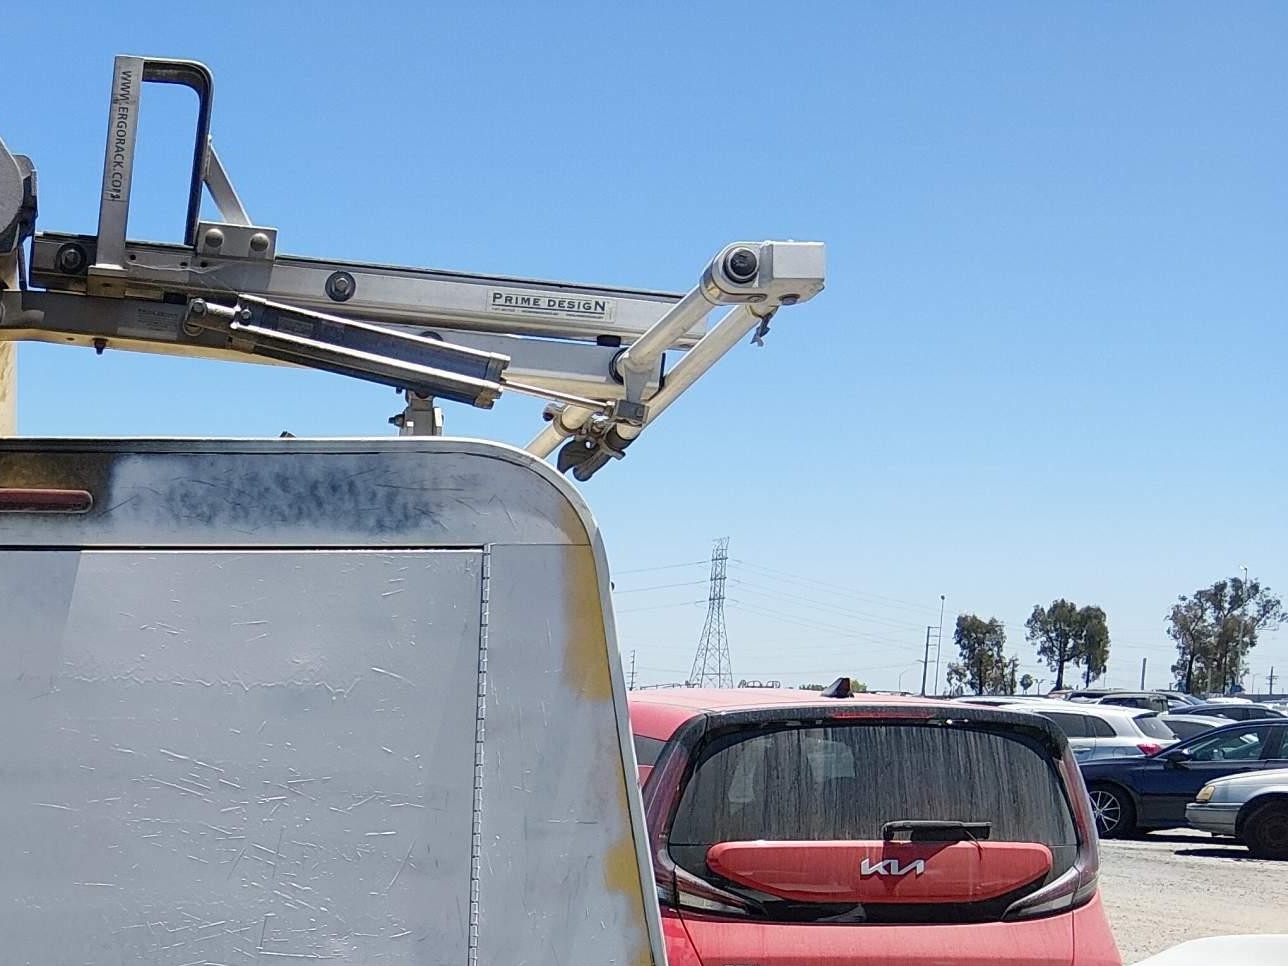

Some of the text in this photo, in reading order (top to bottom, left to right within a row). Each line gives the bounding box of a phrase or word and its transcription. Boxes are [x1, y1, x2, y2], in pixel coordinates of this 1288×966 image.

[492, 292, 606, 312] PRIME DESIGN
[861, 858, 924, 875] KIA
